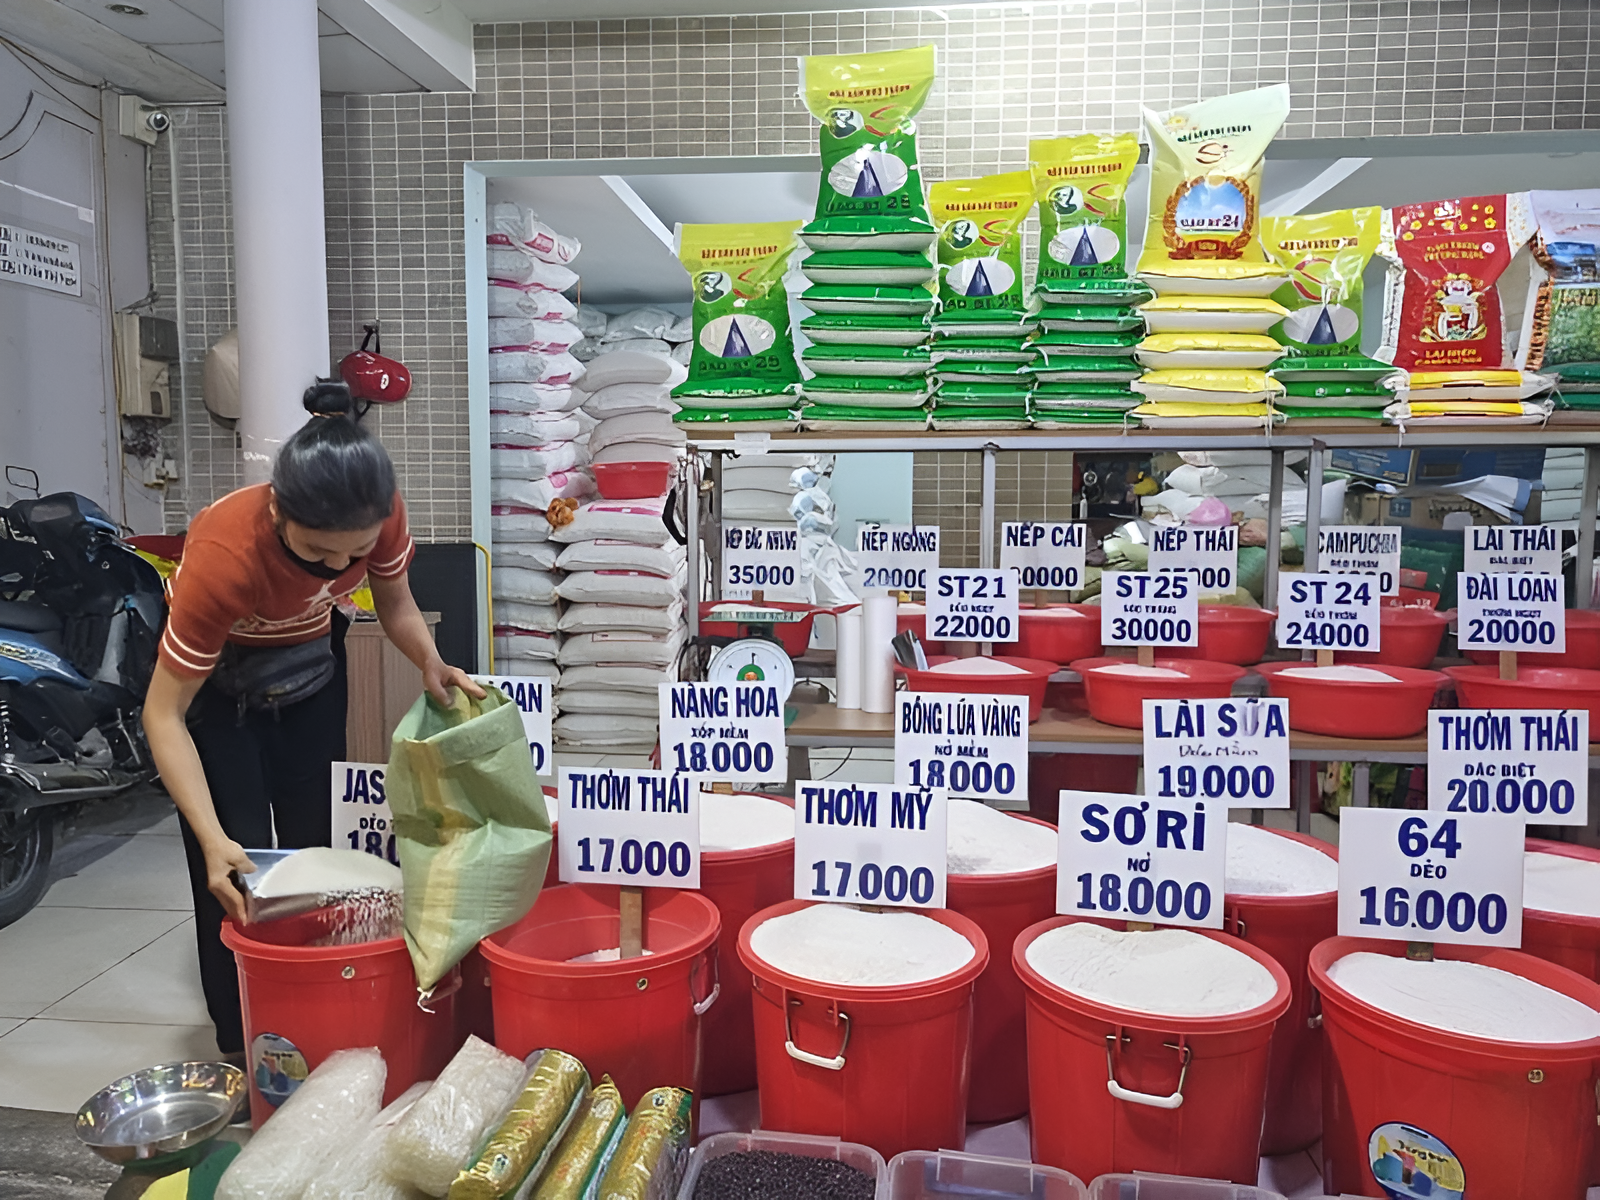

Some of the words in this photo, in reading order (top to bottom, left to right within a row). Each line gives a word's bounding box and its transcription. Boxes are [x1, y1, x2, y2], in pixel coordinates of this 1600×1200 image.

[1006, 521, 1046, 547] NẾP
[1154, 527, 1187, 552] NẾP
[1193, 526, 1234, 552] THÁI
[1474, 525, 1503, 551] LÀI
[1510, 525, 1555, 551] THÁI
[728, 564, 795, 586] 35000
[863, 567, 926, 589] 20000
[1466, 572, 1498, 600] ĐÀI
[1508, 577, 1557, 602] LOAN
[933, 615, 1011, 638] 22000
[1111, 618, 1191, 642] 30000
[1286, 621, 1369, 647] 24000
[1467, 619, 1555, 644] 20000
[671, 683, 729, 718] NÀNG
[736, 687, 779, 718] HOA
[947, 698, 976, 735] LÚA
[982, 698, 1021, 737] VÀNG
[1154, 699, 1205, 738] LÀI
[1217, 698, 1286, 738] SỮA
[1438, 711, 1512, 751] THƠM
[1520, 710, 1579, 751] THÁI
[673, 741, 774, 773] 18.000
[342, 768, 386, 804] JAS
[568, 769, 631, 811] THƠM
[637, 769, 689, 813] THÁI
[908, 759, 1015, 794] 18.000
[1157, 764, 1275, 798] 19.000
[801, 784, 878, 828] THƠM
[890, 784, 933, 830] MỸ
[1447, 778, 1575, 814] 20.000
[1398, 817, 1462, 859] 64
[577, 837, 691, 877] 17.000
[811, 860, 934, 904] 17.000
[1076, 872, 1211, 921] 18.000
[1359, 886, 1508, 935] 16.000
